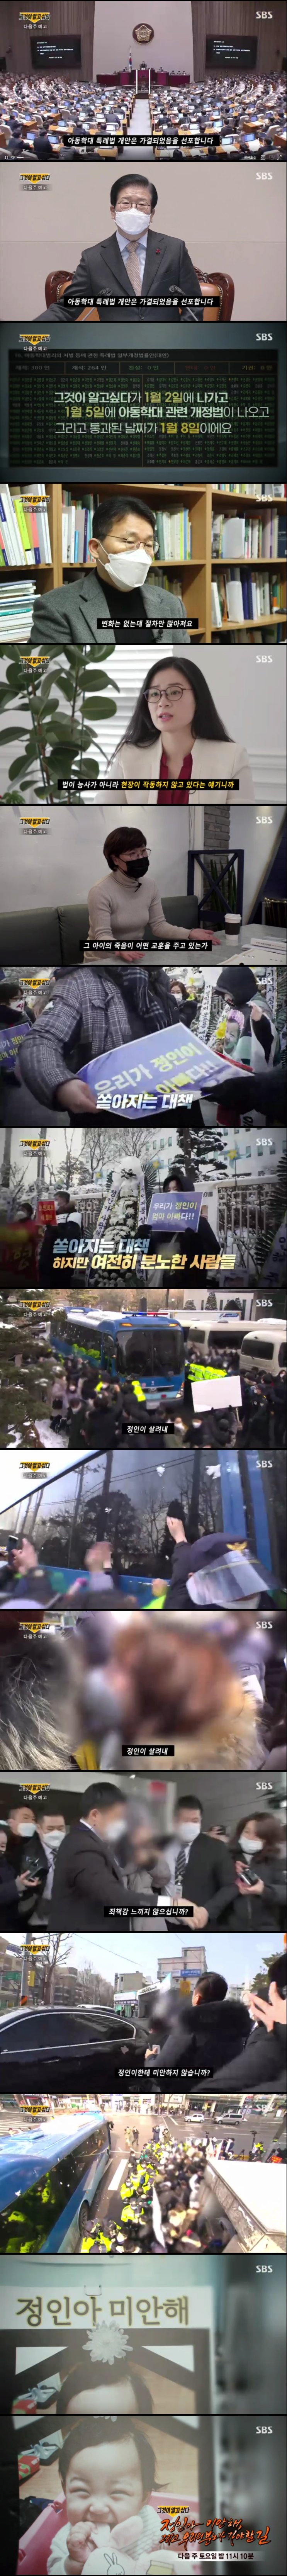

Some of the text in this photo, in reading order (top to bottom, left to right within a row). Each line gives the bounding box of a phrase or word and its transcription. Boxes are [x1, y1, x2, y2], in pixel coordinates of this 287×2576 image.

[94, 1042, 202, 1097] 우리가 정인이
[152, 1212, 194, 1220] 엄마 아빠다!!
[16, 2296, 189, 2327] 정인아 미안해
